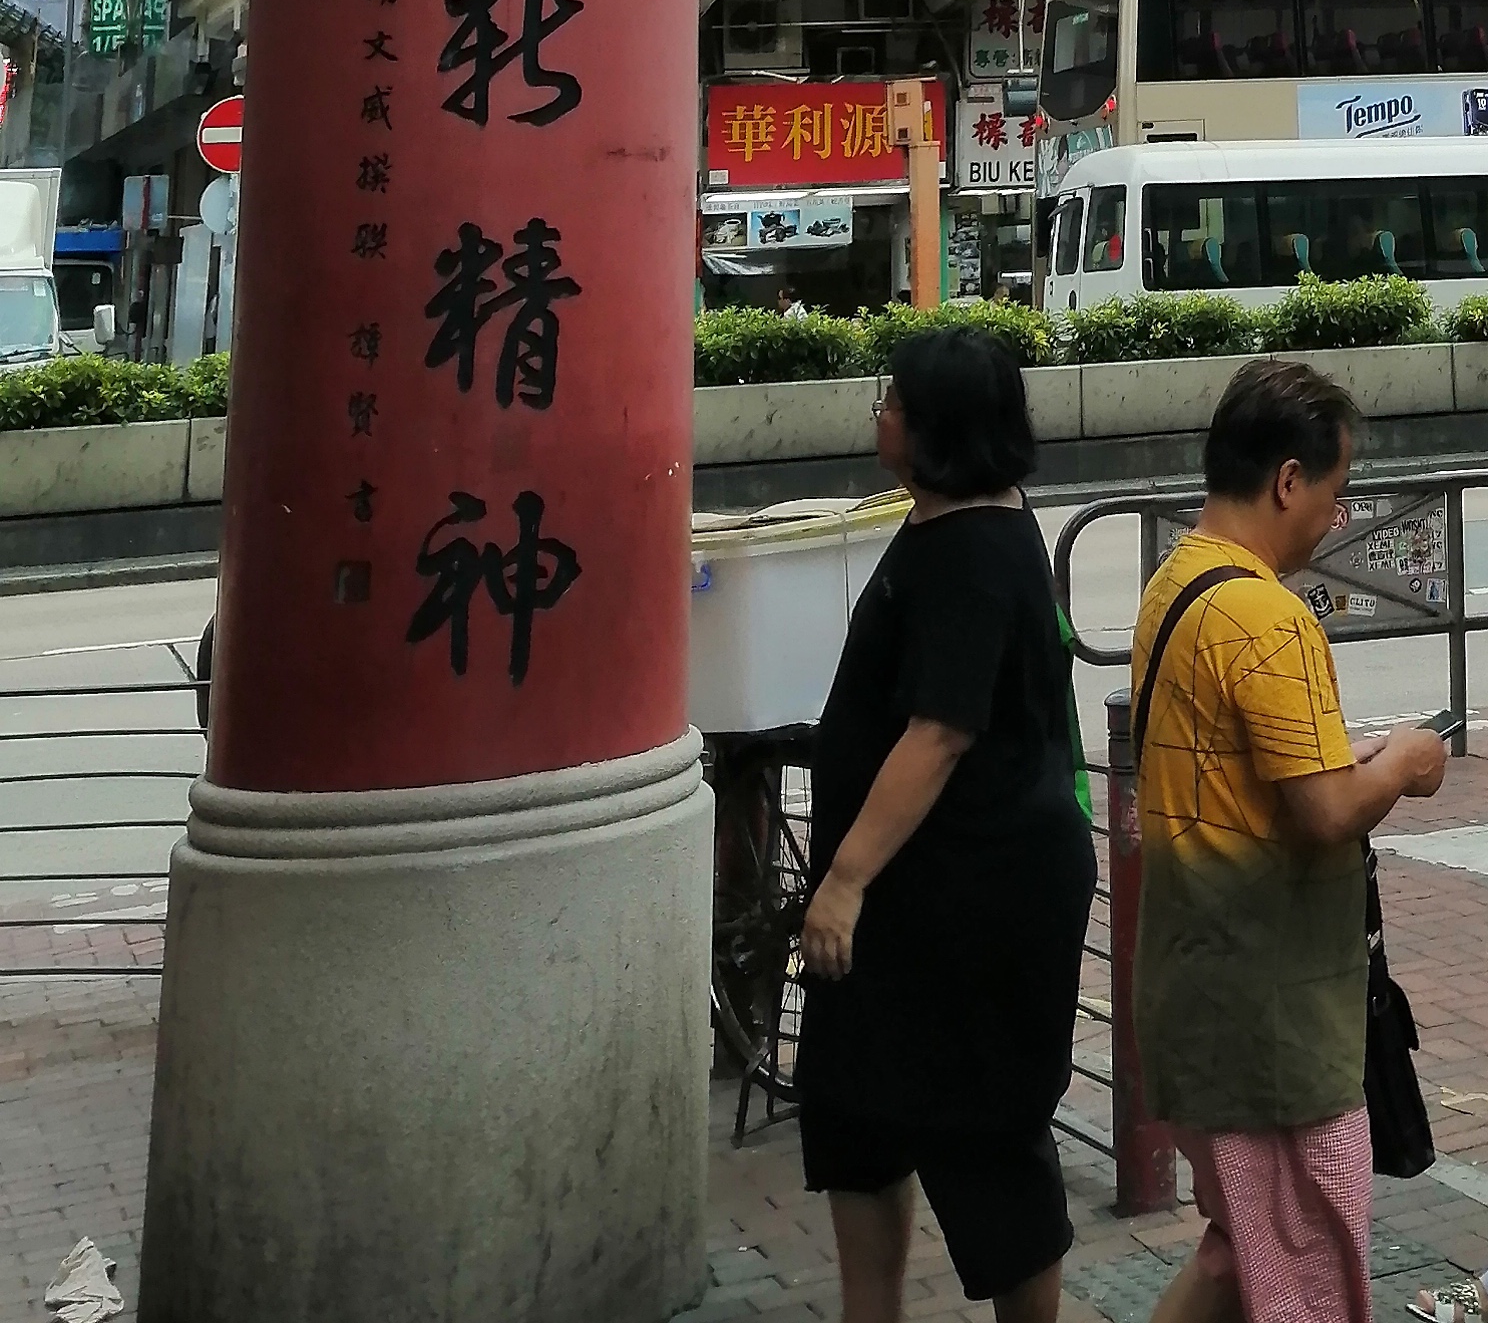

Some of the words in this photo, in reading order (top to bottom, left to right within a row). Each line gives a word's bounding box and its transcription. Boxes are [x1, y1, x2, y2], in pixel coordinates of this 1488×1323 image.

[1335, 95, 1416, 134] Tempo
[969, 161, 1001, 183] BIU
[1009, 158, 1035, 183] KE
[1373, 526, 1400, 540] VIDEO
